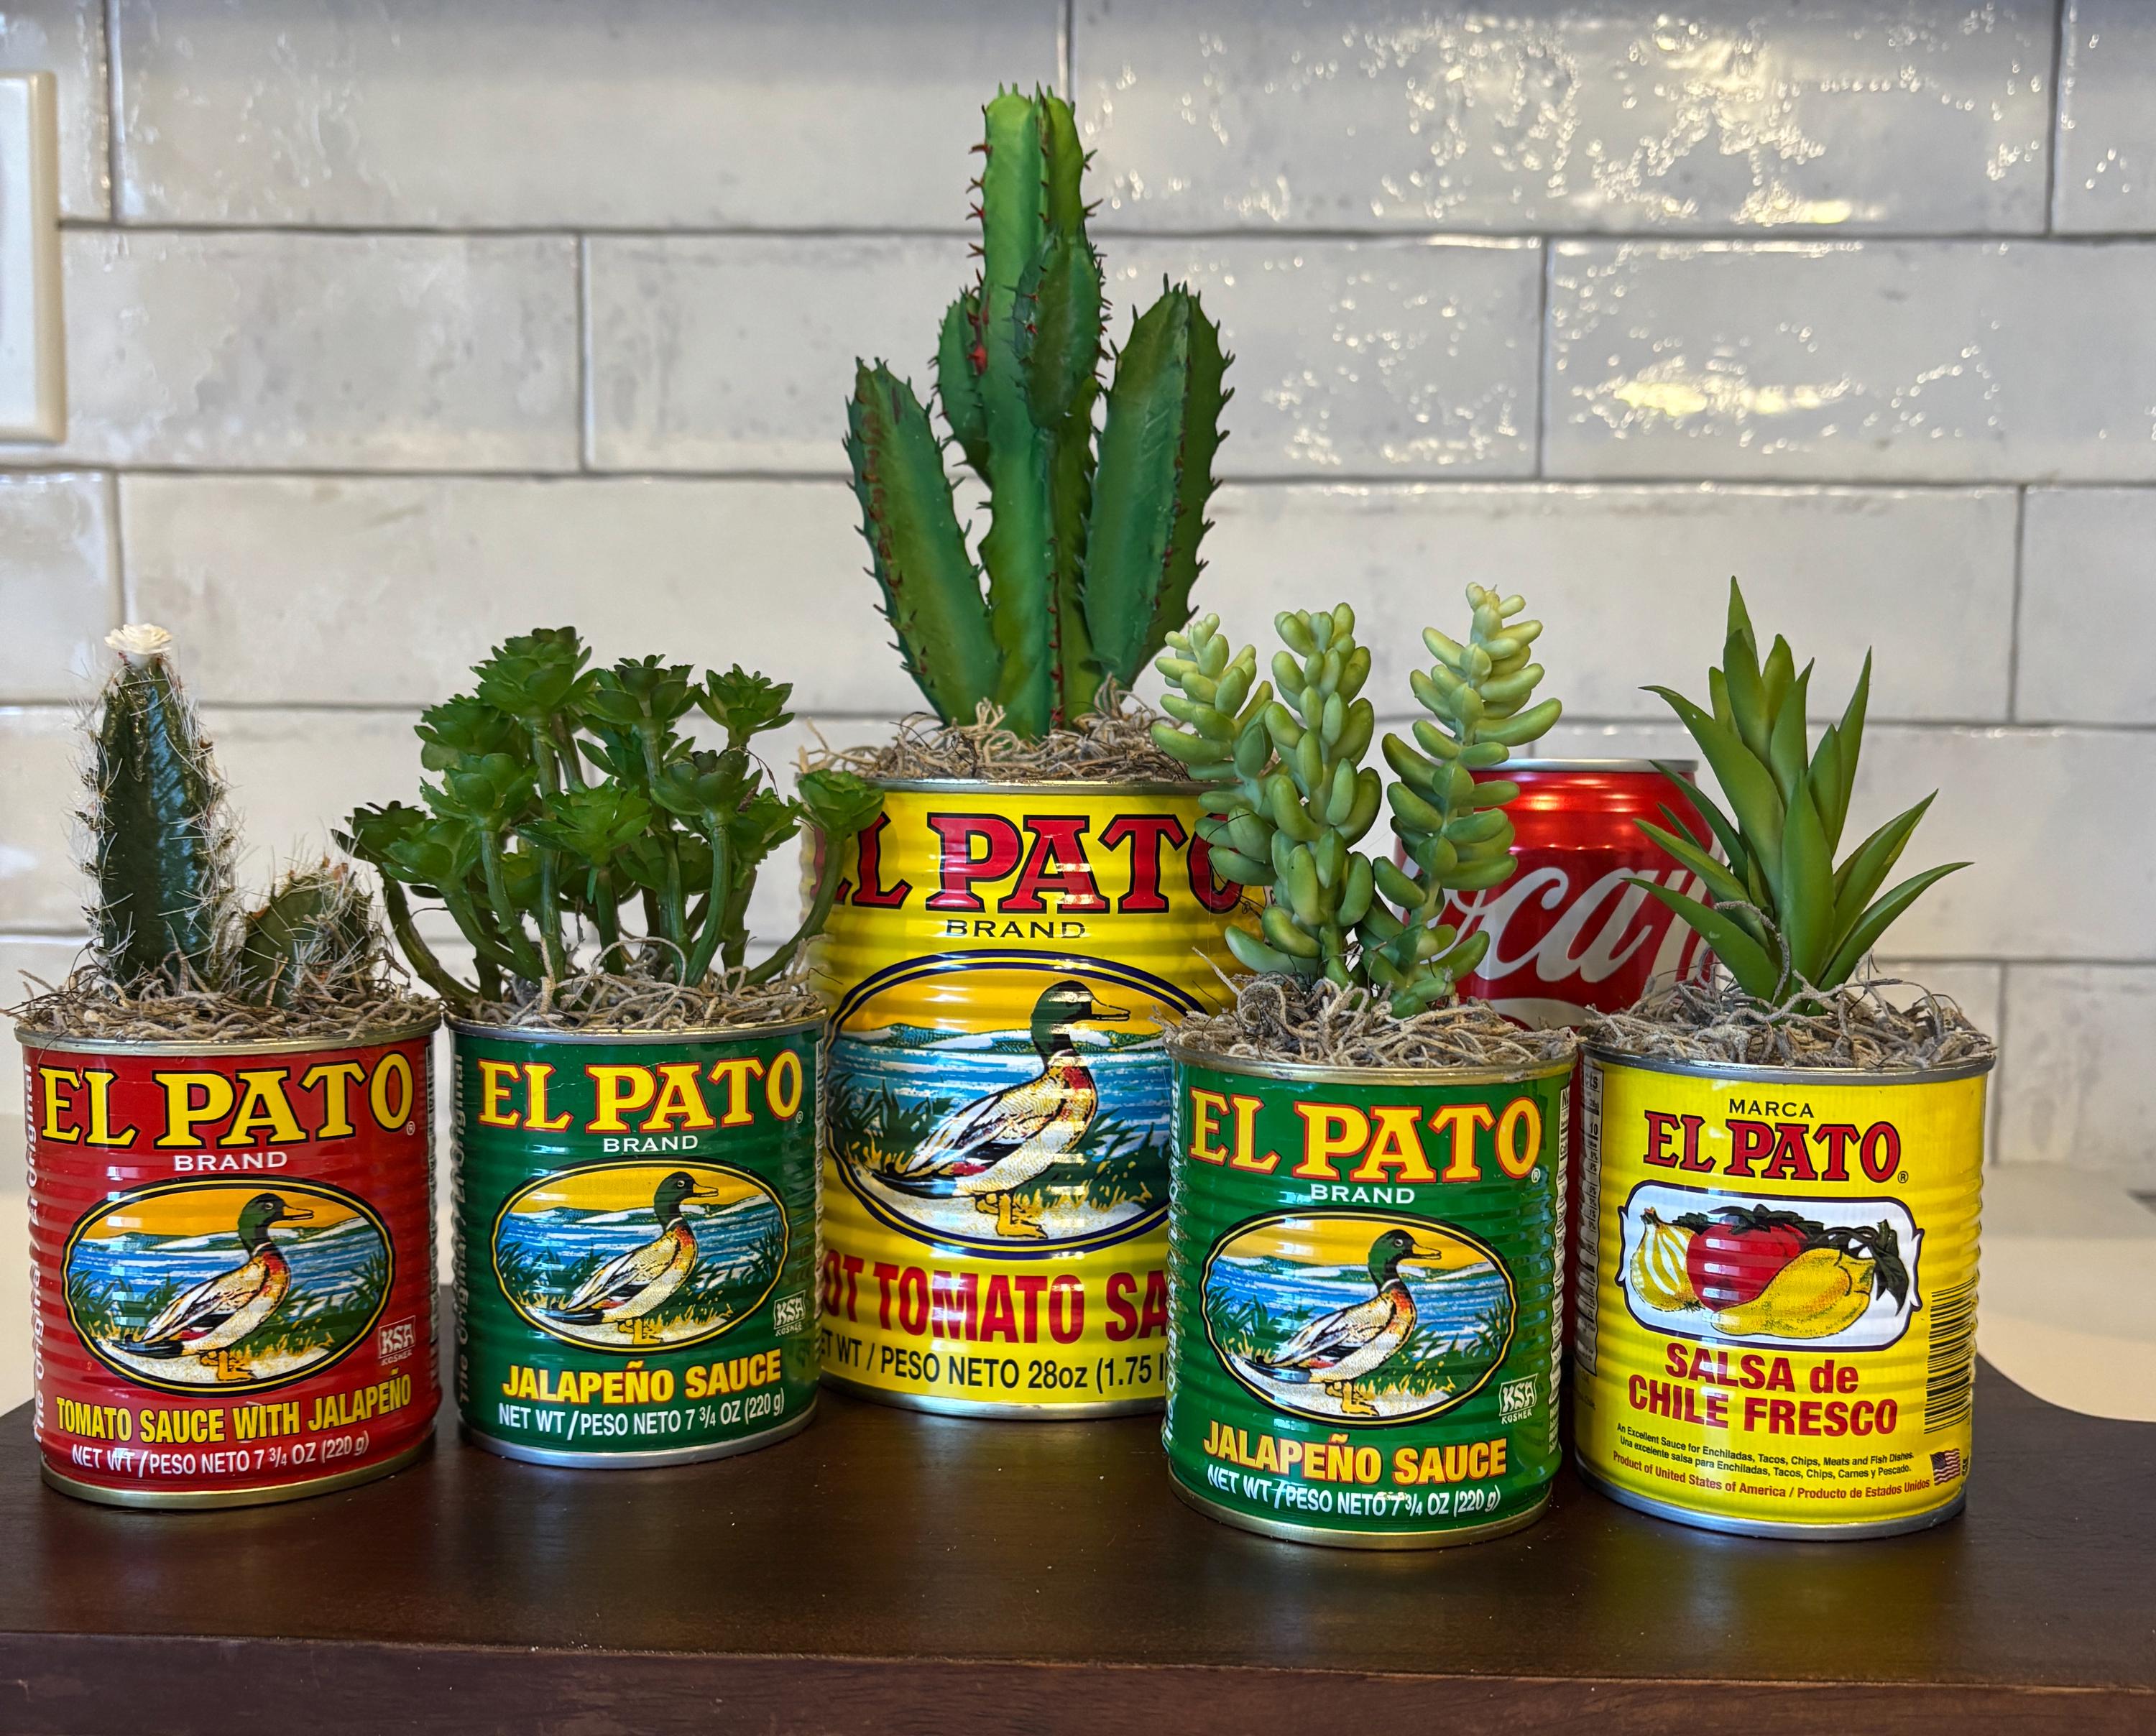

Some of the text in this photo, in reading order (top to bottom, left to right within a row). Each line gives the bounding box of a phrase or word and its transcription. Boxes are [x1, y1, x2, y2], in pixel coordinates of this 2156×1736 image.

[810, 811, 913, 910] L
[946, 919, 1086, 939] BRAND
[39, 1065, 139, 1148] EL
[153, 1050, 415, 1150] PATO
[477, 1057, 573, 1131] EL
[584, 1048, 803, 1134] PATO
[1728, 1099, 1814, 1118] MARCA
[603, 1135, 698, 1153] BRAND
[1189, 1086, 1542, 1183] EL PATO
[1643, 1109, 1902, 1183] EL PATO
[173, 1151, 287, 1172] BRAND
[1310, 1183, 1415, 1205] BRAND
[775, 1296, 804, 1326] KSA
[824, 1248, 865, 1324] OT
[872, 1261, 1084, 1344] TOMATO
[382, 1324, 415, 1355] KSA
[836, 1333, 862, 1367] WT
[880, 1344, 940, 1382] PESO
[949, 1355, 1020, 1388] NETO
[1028, 1359, 1088, 1389] 28oz
[1096, 1354, 1152, 1395] (1.75
[502, 1347, 782, 1405] JALAPEÑO SAUCE
[1664, 1342, 1859, 1395] SALSA de
[55, 1366, 412, 1444] TOMATO SAUCE WITH JALAPEÑO
[499, 1402, 531, 1429] NET
[633, 1409, 682, 1436] NETO
[685, 1408, 696, 1431] 7
[719, 1400, 742, 1426] OZ
[745, 1392, 772, 1425] (220
[773, 1387, 786, 1417] g)
[1501, 1380, 1535, 1413] KSA
[1501, 1408, 1533, 1426] KOSHER
[1628, 1373, 1898, 1438] CHILE FRESCO
[72, 1443, 103, 1469] NET
[201, 1450, 250, 1474] NETO
[253, 1449, 265, 1470] 7
[292, 1441, 317, 1465] OZ
[321, 1434, 354, 1464] (220
[354, 1429, 371, 1457] g)
[1203, 1419, 1508, 1486] JALAPEÑO SAUCE
[1617, 1422, 1626, 1433] An
[1627, 1426, 1659, 1444] Excellent
[1661, 1436, 1687, 1451] Sauce
[1688, 1442, 1700, 1454] for
[1703, 1446, 1756, 1463] Enchiladas,
[1757, 1453, 1789, 1466] Tacos,
[1790, 1456, 1821, 1467] Chips,
[1823, 1456, 1850, 1467] Meats
[1851, 1455, 1869, 1466] and
[1870, 1454, 1888, 1464] Fish
[1620, 1434, 1912, 1481] Una excelente salsa para Enchiladas, Tacos, Chips, Carnes y Pescado.
[1207, 1463, 1240, 1495] NET
[1337, 1490, 1386, 1516] NETO
[1427, 1491, 1450, 1516] OZ
[1453, 1487, 1485, 1518] (220
[1484, 1484, 1501, 1513] g)
[1613, 1449, 1643, 1472] Product
[1644, 1463, 1654, 1474] of
[1654, 1467, 1687, 1484] United
[1688, 1474, 1723, 1490] States
[1725, 1481, 1737, 1492] of
[1739, 1482, 1786, 1497] America
[1797, 1487, 1847, 1499] Producto
[1849, 1487, 1863, 1498] de
[1865, 1484, 1902, 1497] Estados
[1904, 1478, 1931, 1493] Unidos
